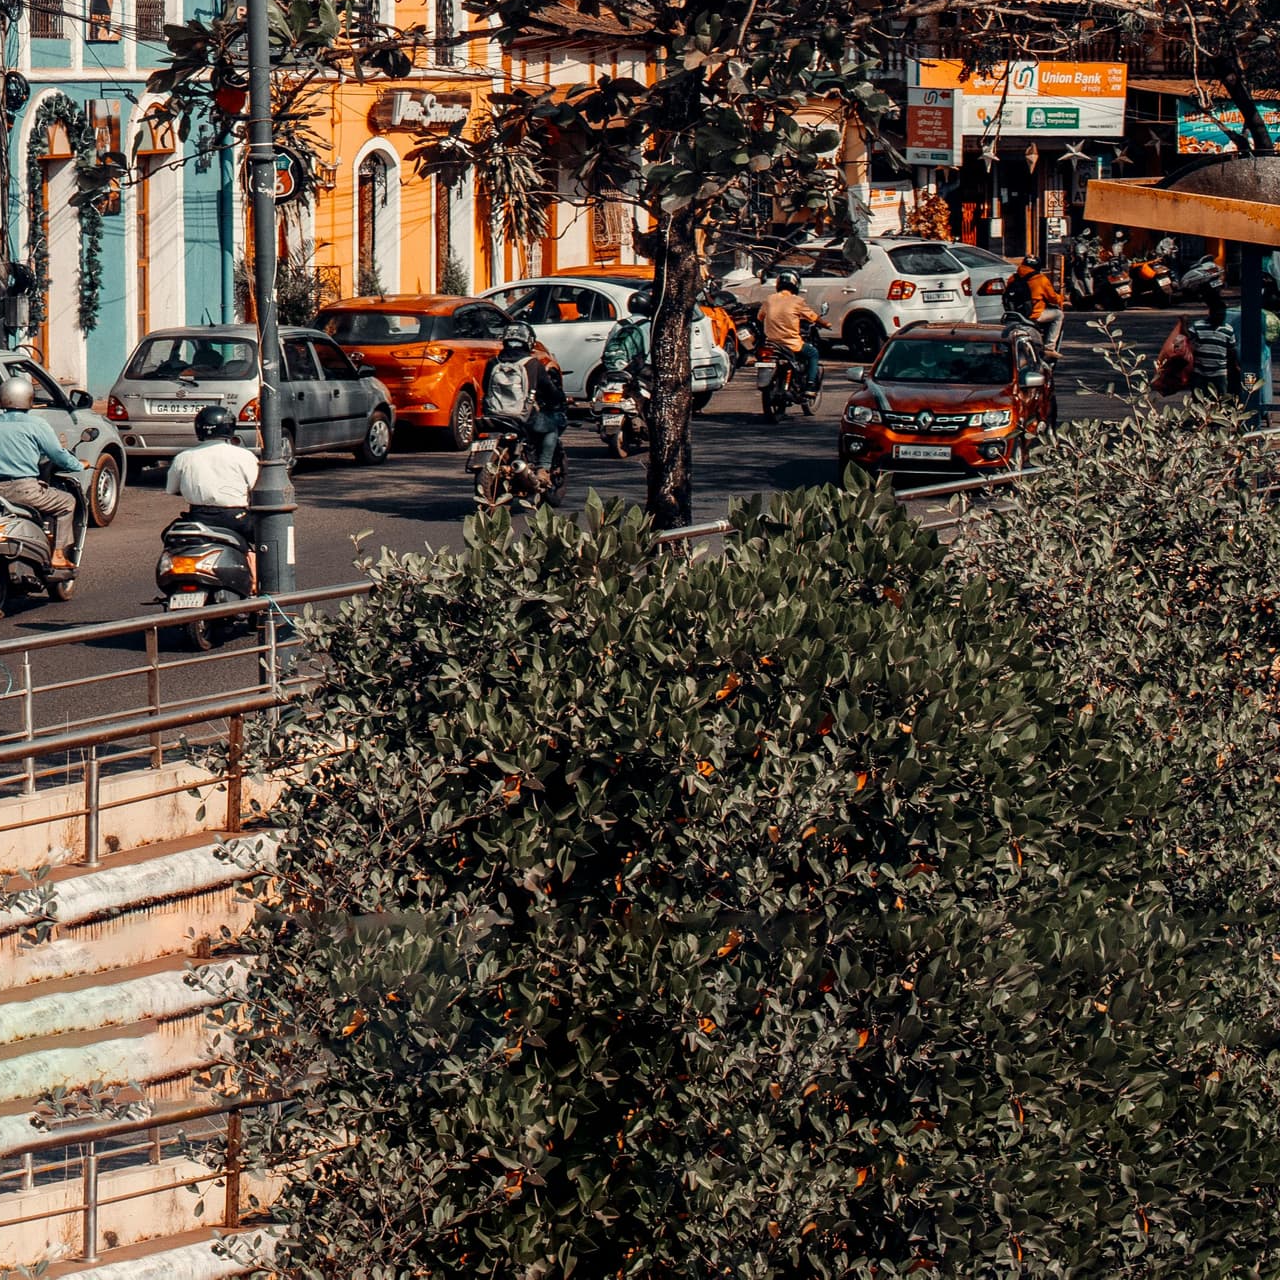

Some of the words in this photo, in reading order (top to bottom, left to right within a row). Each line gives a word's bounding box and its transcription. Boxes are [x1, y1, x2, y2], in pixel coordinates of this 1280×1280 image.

[1042, 72, 1072, 84] Union
[1074, 72, 1102, 85] Bank
[157, 405, 168, 413] GA
[170, 404, 180, 412] 01
